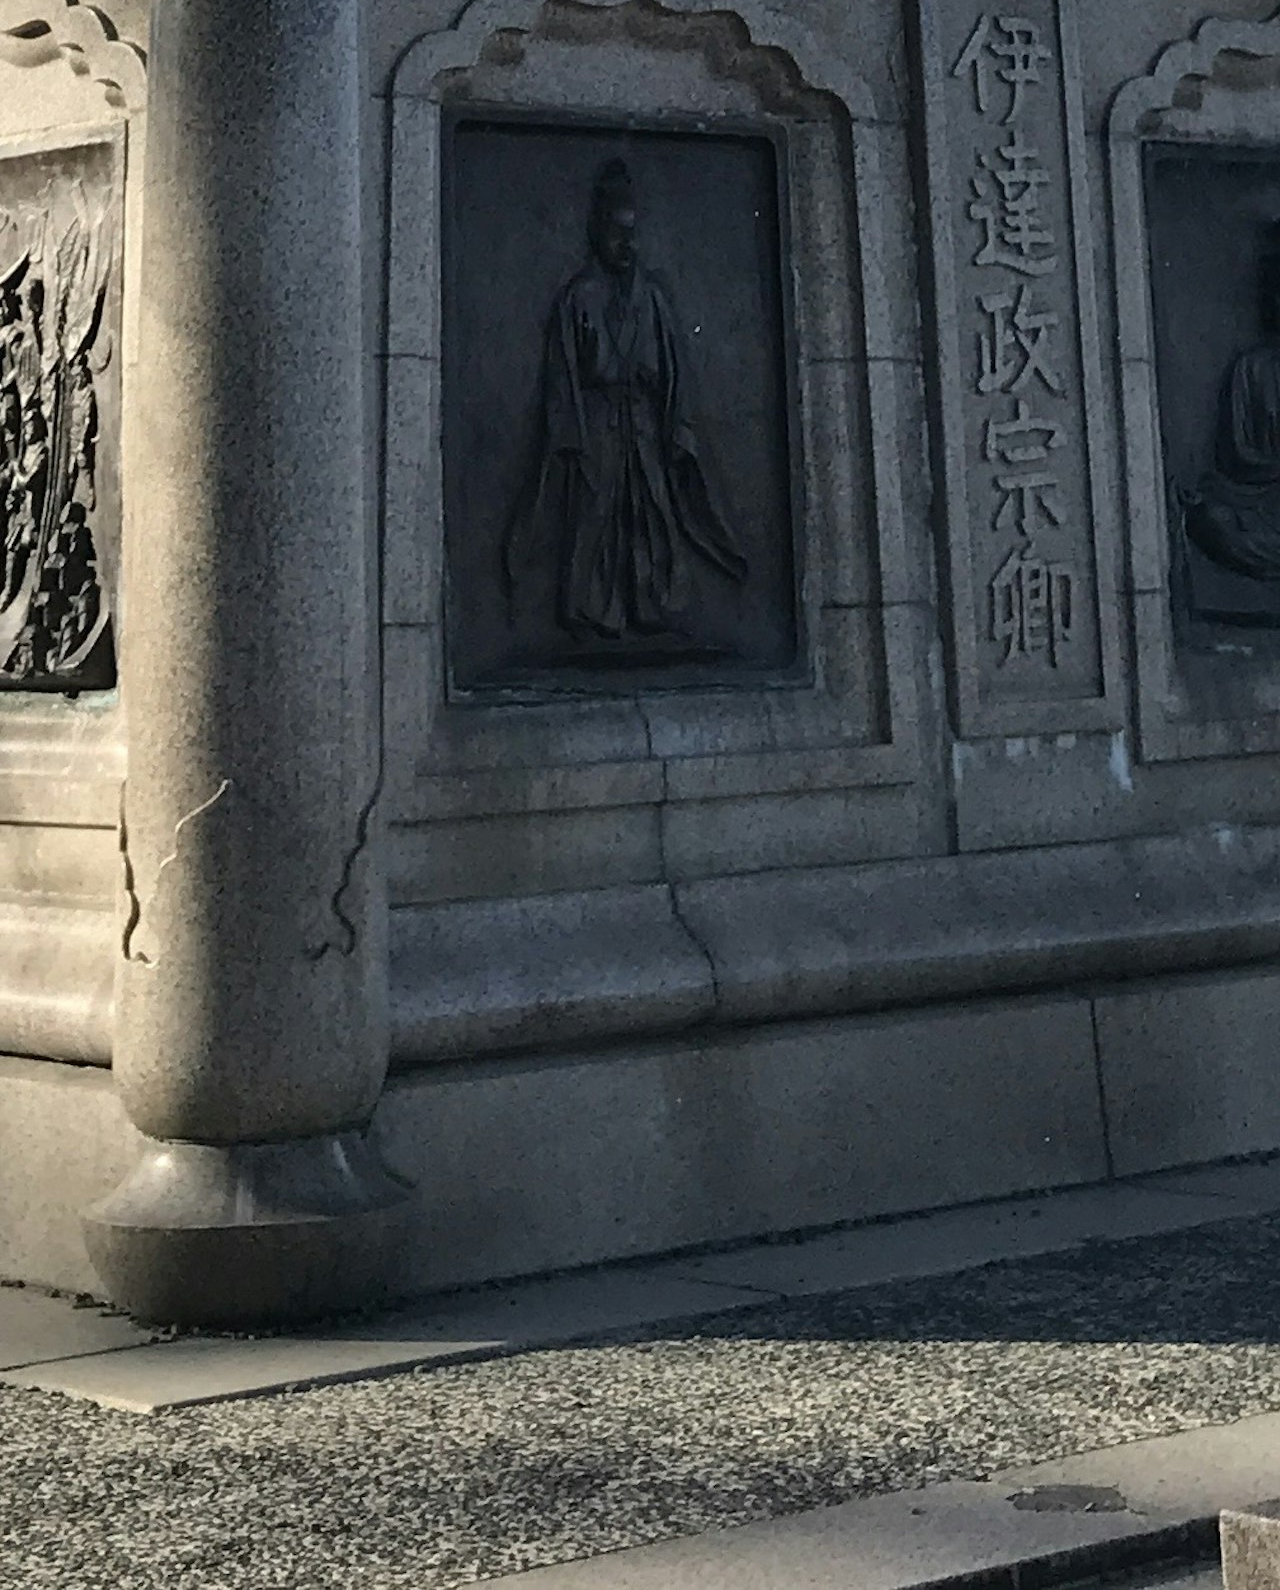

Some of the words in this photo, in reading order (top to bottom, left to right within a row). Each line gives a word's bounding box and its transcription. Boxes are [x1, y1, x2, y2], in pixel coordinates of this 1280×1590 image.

[950, 13, 1073, 668] 伊達政宗卿
